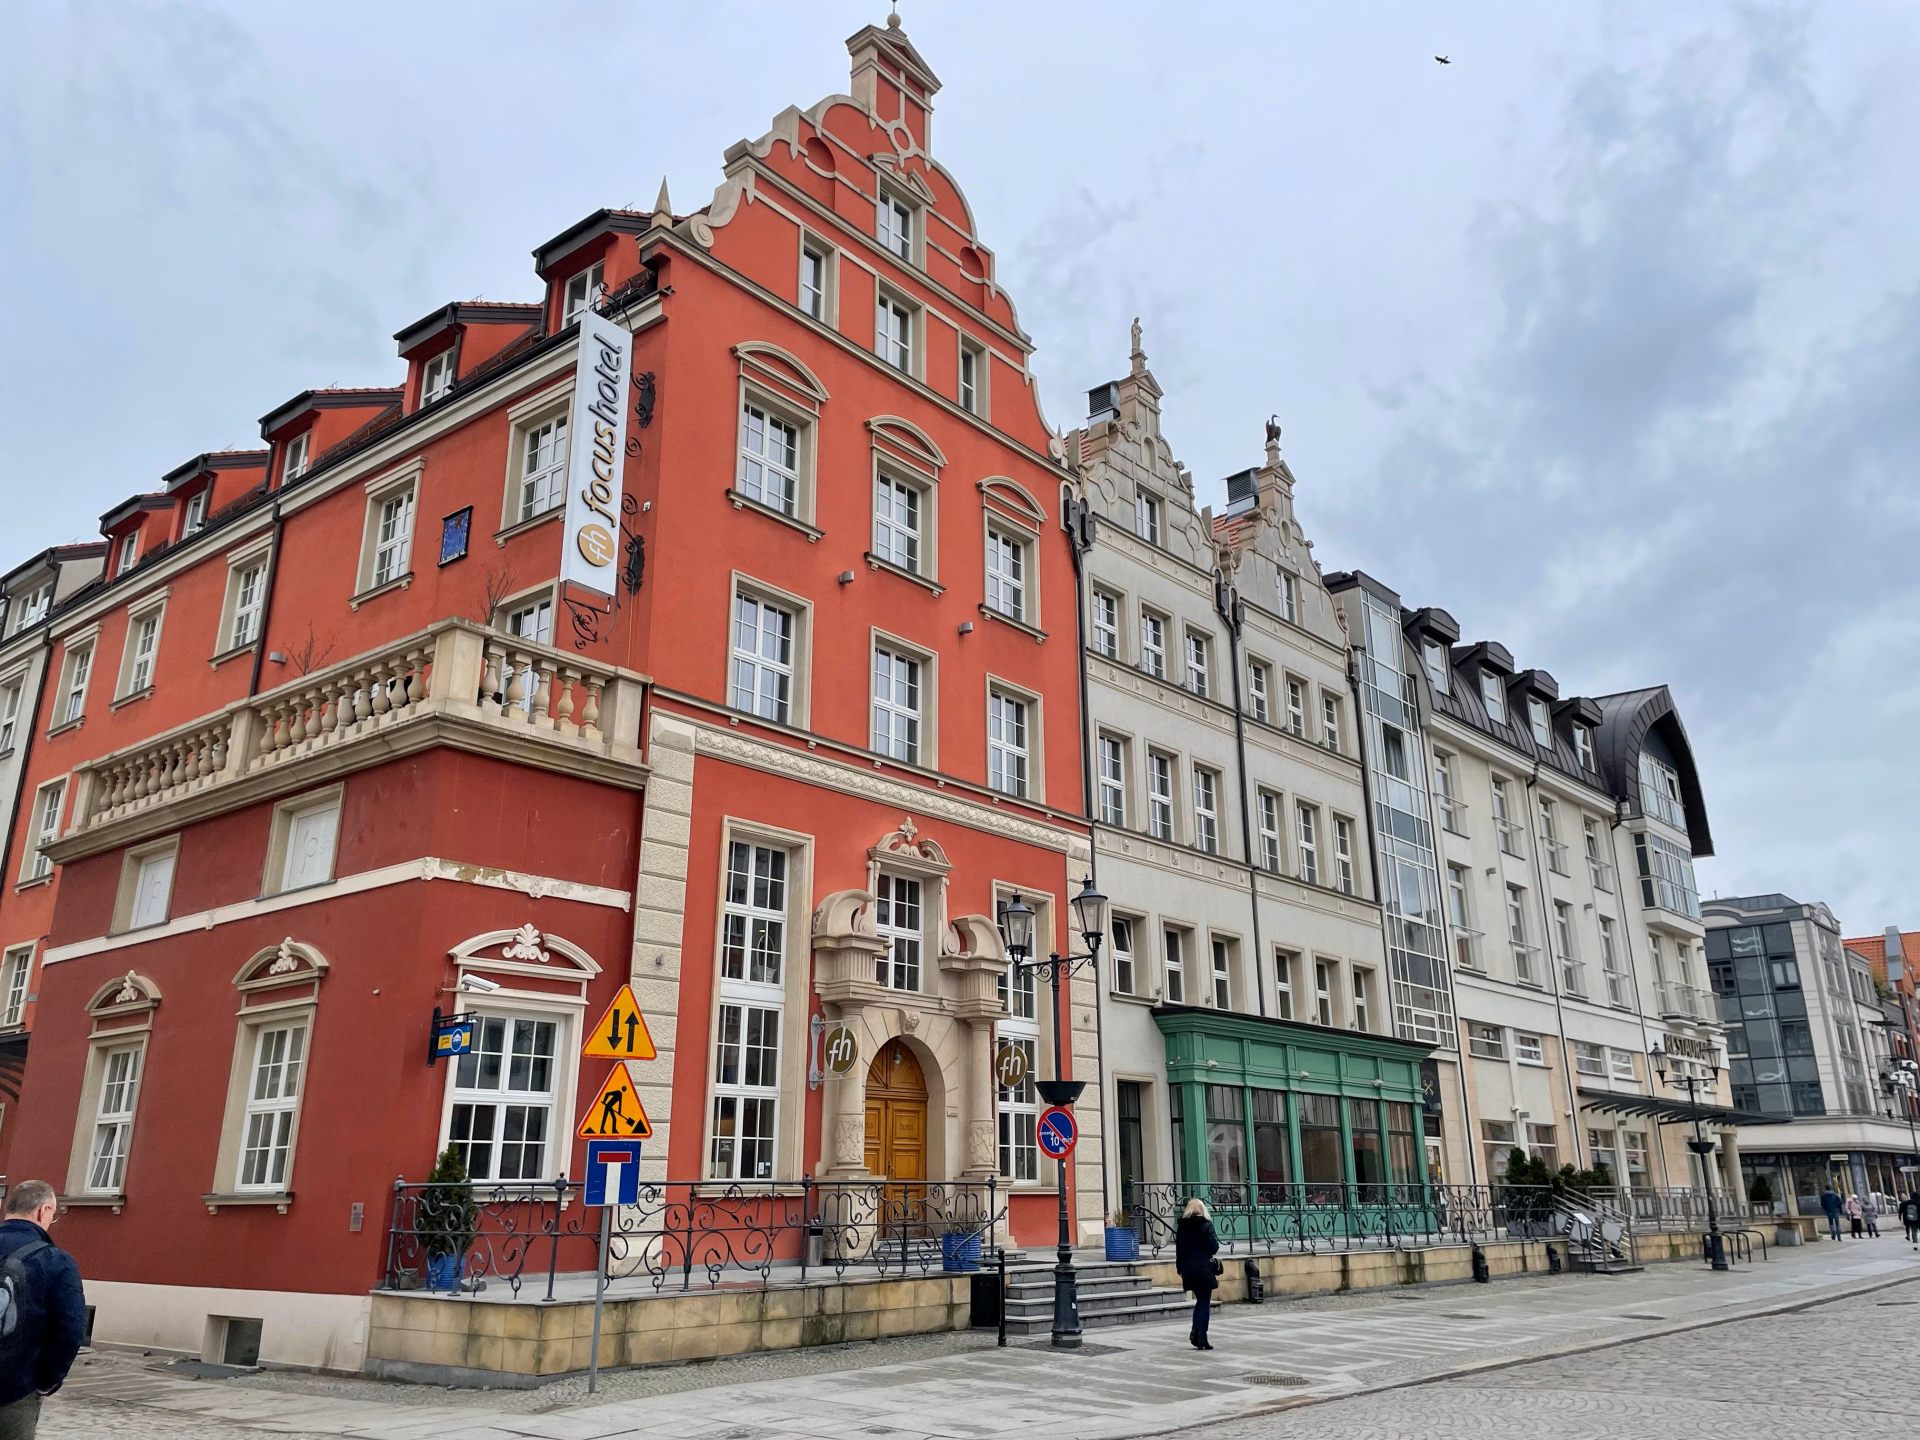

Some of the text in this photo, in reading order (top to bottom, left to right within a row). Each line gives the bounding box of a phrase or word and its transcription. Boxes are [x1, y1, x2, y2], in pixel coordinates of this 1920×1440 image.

[582, 332, 623, 528] focushotel
[829, 1027, 851, 1070] fh
[1000, 1046, 1022, 1084] fh
[1050, 1136, 1060, 1147] 10
